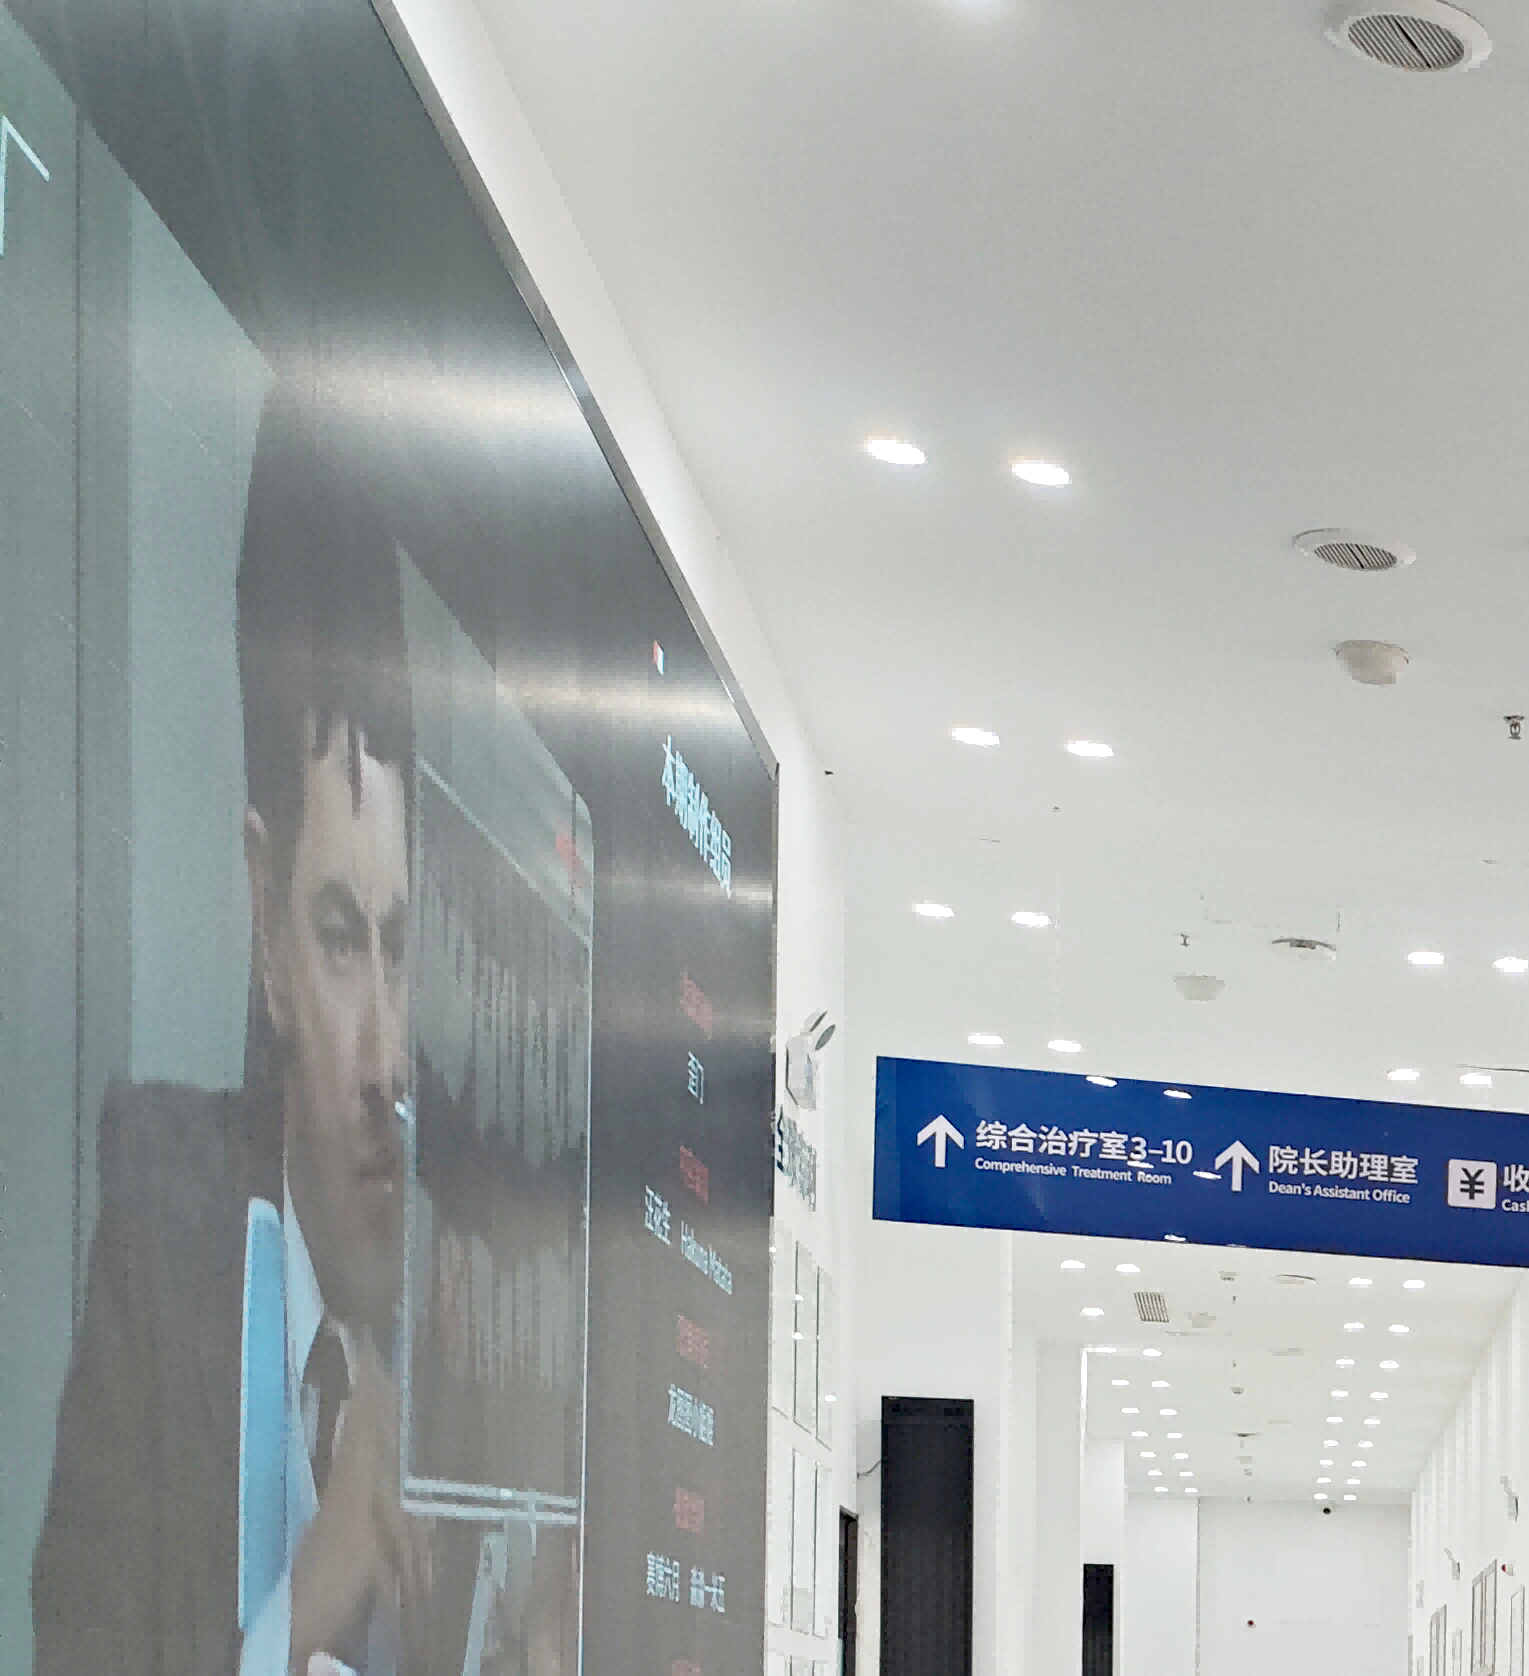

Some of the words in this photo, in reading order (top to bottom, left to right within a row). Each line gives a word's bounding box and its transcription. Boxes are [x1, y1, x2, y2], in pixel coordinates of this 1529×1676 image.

[976, 1120, 1193, 1168] 综合治疗室3-10
[974, 1157, 1067, 1177] Comprehensive
[1072, 1165, 1132, 1182] Treatment
[1137, 1171, 1172, 1185] Room
[1268, 1144, 1419, 1187] 院长助理室
[1268, 1180, 1311, 1196] Dean's
[1313, 1183, 1371, 1200] Assistant
[1373, 1187, 1411, 1204] Office
